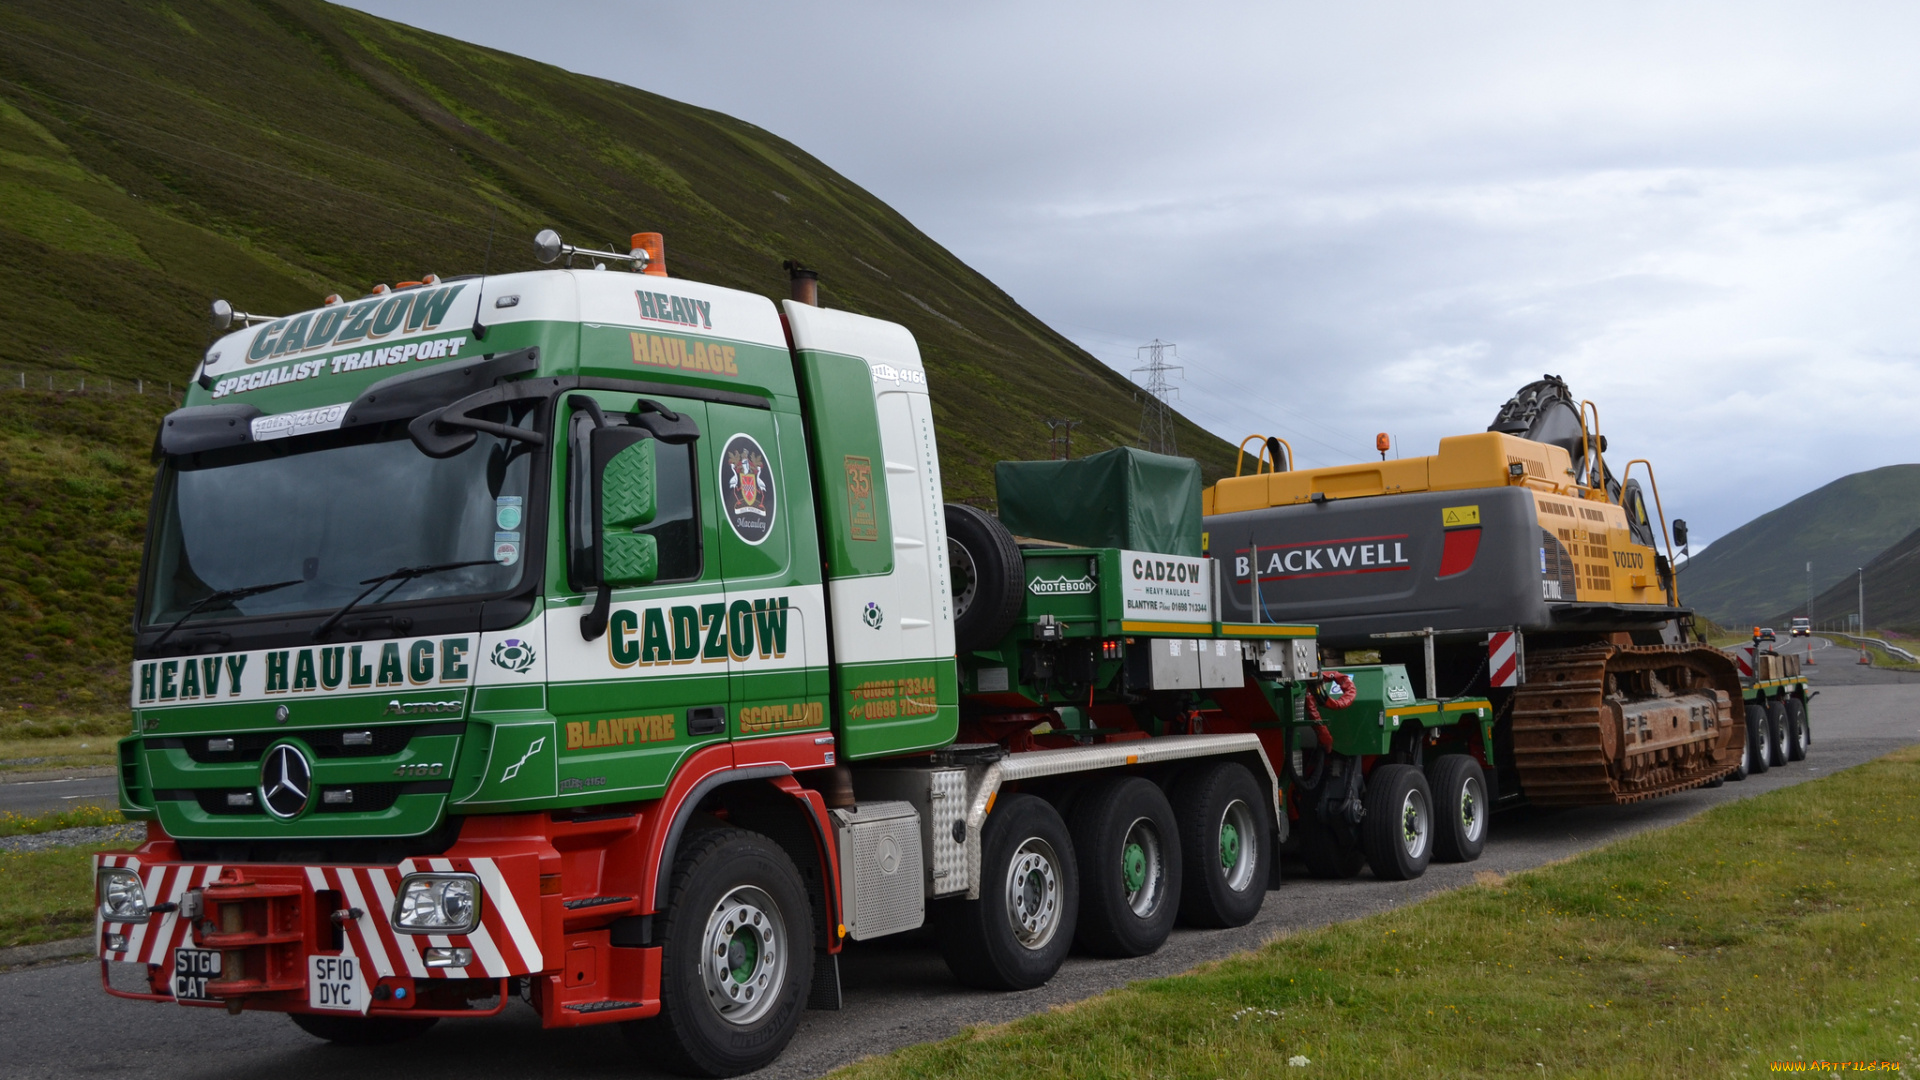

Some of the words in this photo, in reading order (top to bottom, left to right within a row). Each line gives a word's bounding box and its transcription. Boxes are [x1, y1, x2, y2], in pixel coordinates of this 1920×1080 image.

[634, 289, 712, 330] HEAVY
[245, 284, 467, 364] CADZOW
[630, 332, 738, 377] HAULAGE
[212, 358, 327, 399] SPECIALIST
[331, 337, 467, 374] TRANSPORT
[296, 406, 342, 426] 4160
[849, 469, 870, 494] 35
[1132, 559, 1200, 584] CADZOW
[1613, 551, 1643, 569] VOLVO
[1033, 582, 1092, 592] NOOTEBOOM
[1145, 586, 1164, 596] HEAVY
[1165, 587, 1190, 597] HAULAGE
[1127, 599, 1158, 610] BLANTYRE
[1171, 602, 1188, 612] 01698
[607, 596, 789, 669] CADZOW
[139, 654, 248, 704] HEAVY
[264, 638, 469, 694] HAULAGE
[863, 680, 895, 700] 01698
[864, 700, 897, 720] 01698
[566, 714, 676, 750] BLANTYRE
[740, 702, 824, 733] SCOTLAND
[176, 976, 209, 998] CAT
[319, 983, 351, 1004] DYC
[731, 1002, 790, 1047] MICHELIN
